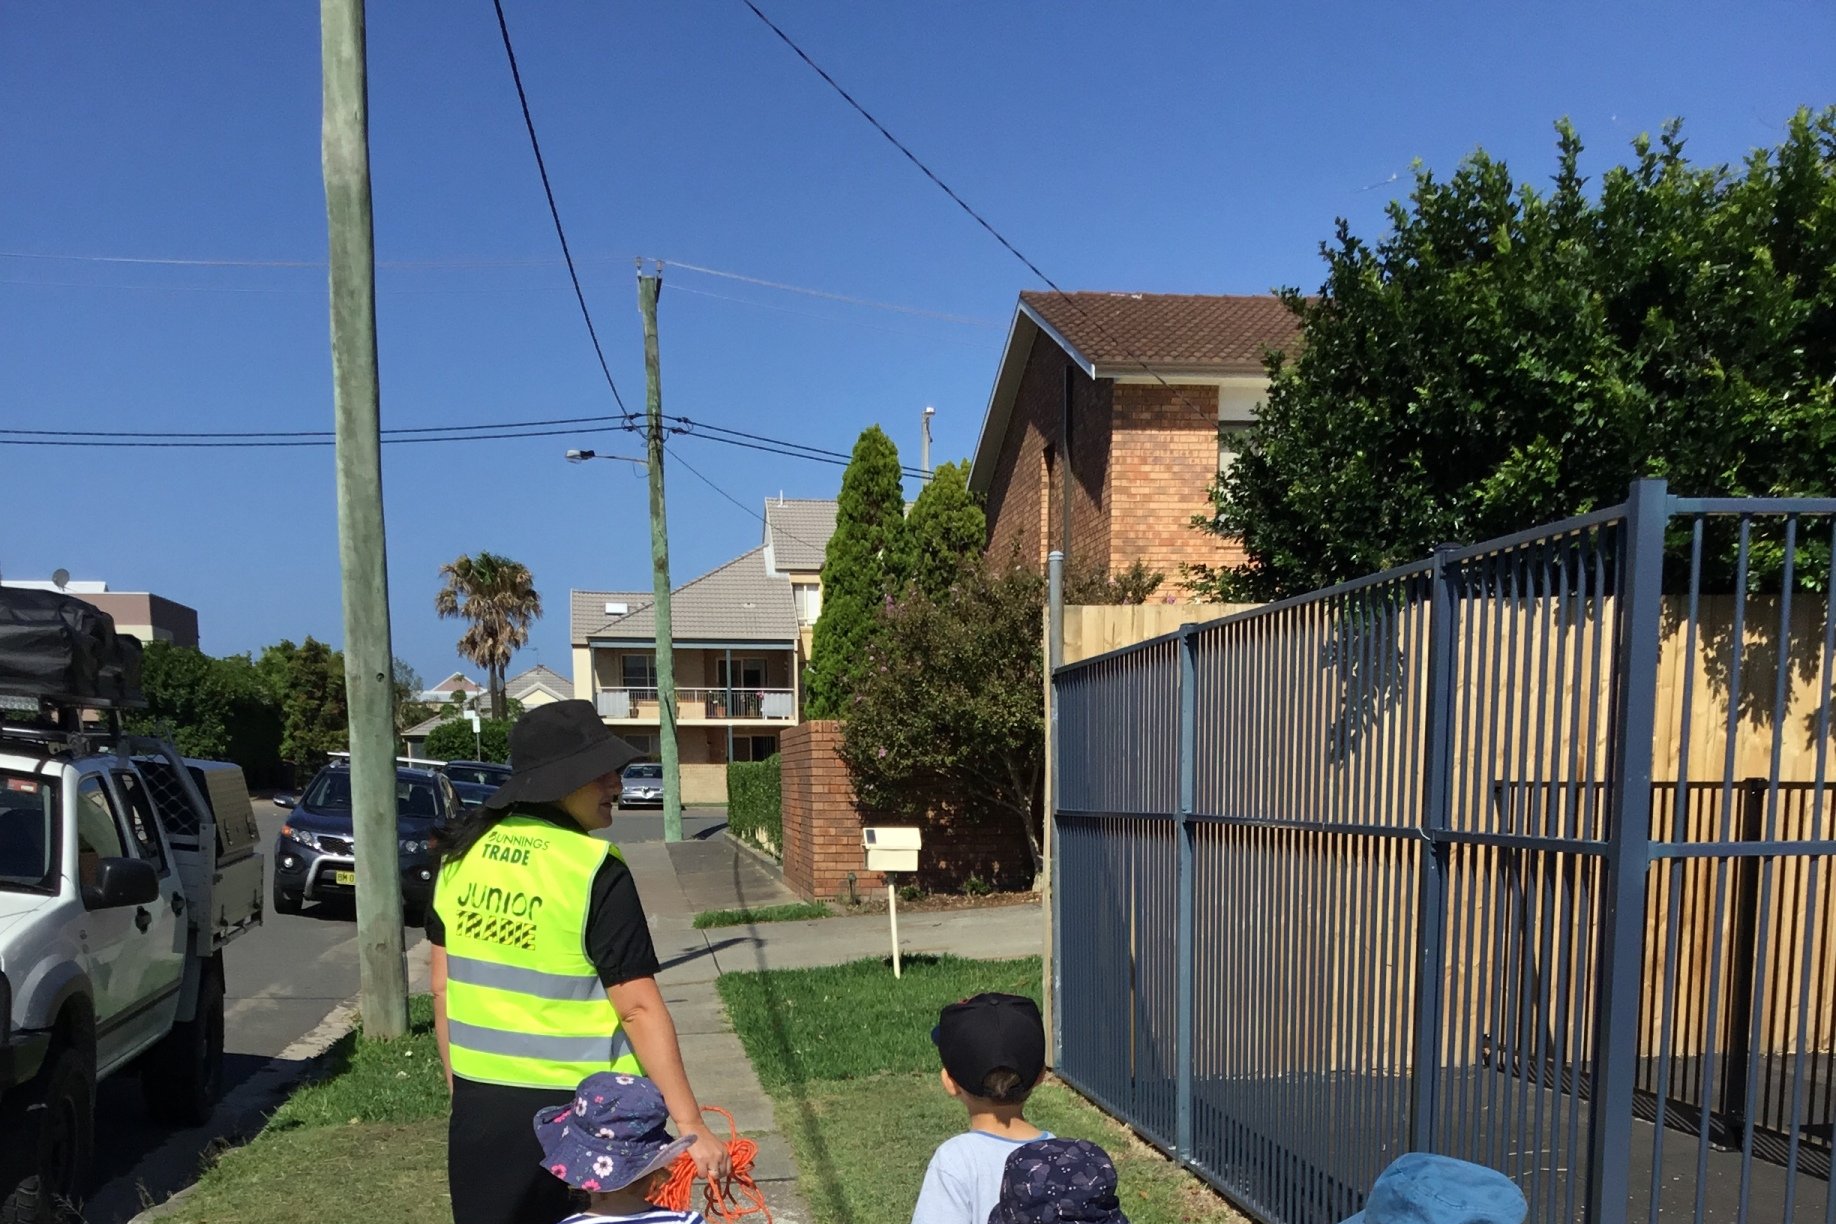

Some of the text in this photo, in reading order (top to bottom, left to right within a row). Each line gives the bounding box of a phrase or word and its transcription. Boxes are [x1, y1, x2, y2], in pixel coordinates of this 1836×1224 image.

[488, 831, 550, 851] BUNNINGS
[482, 843, 531, 866] TRADE
[456, 910, 537, 951] TRADIE
